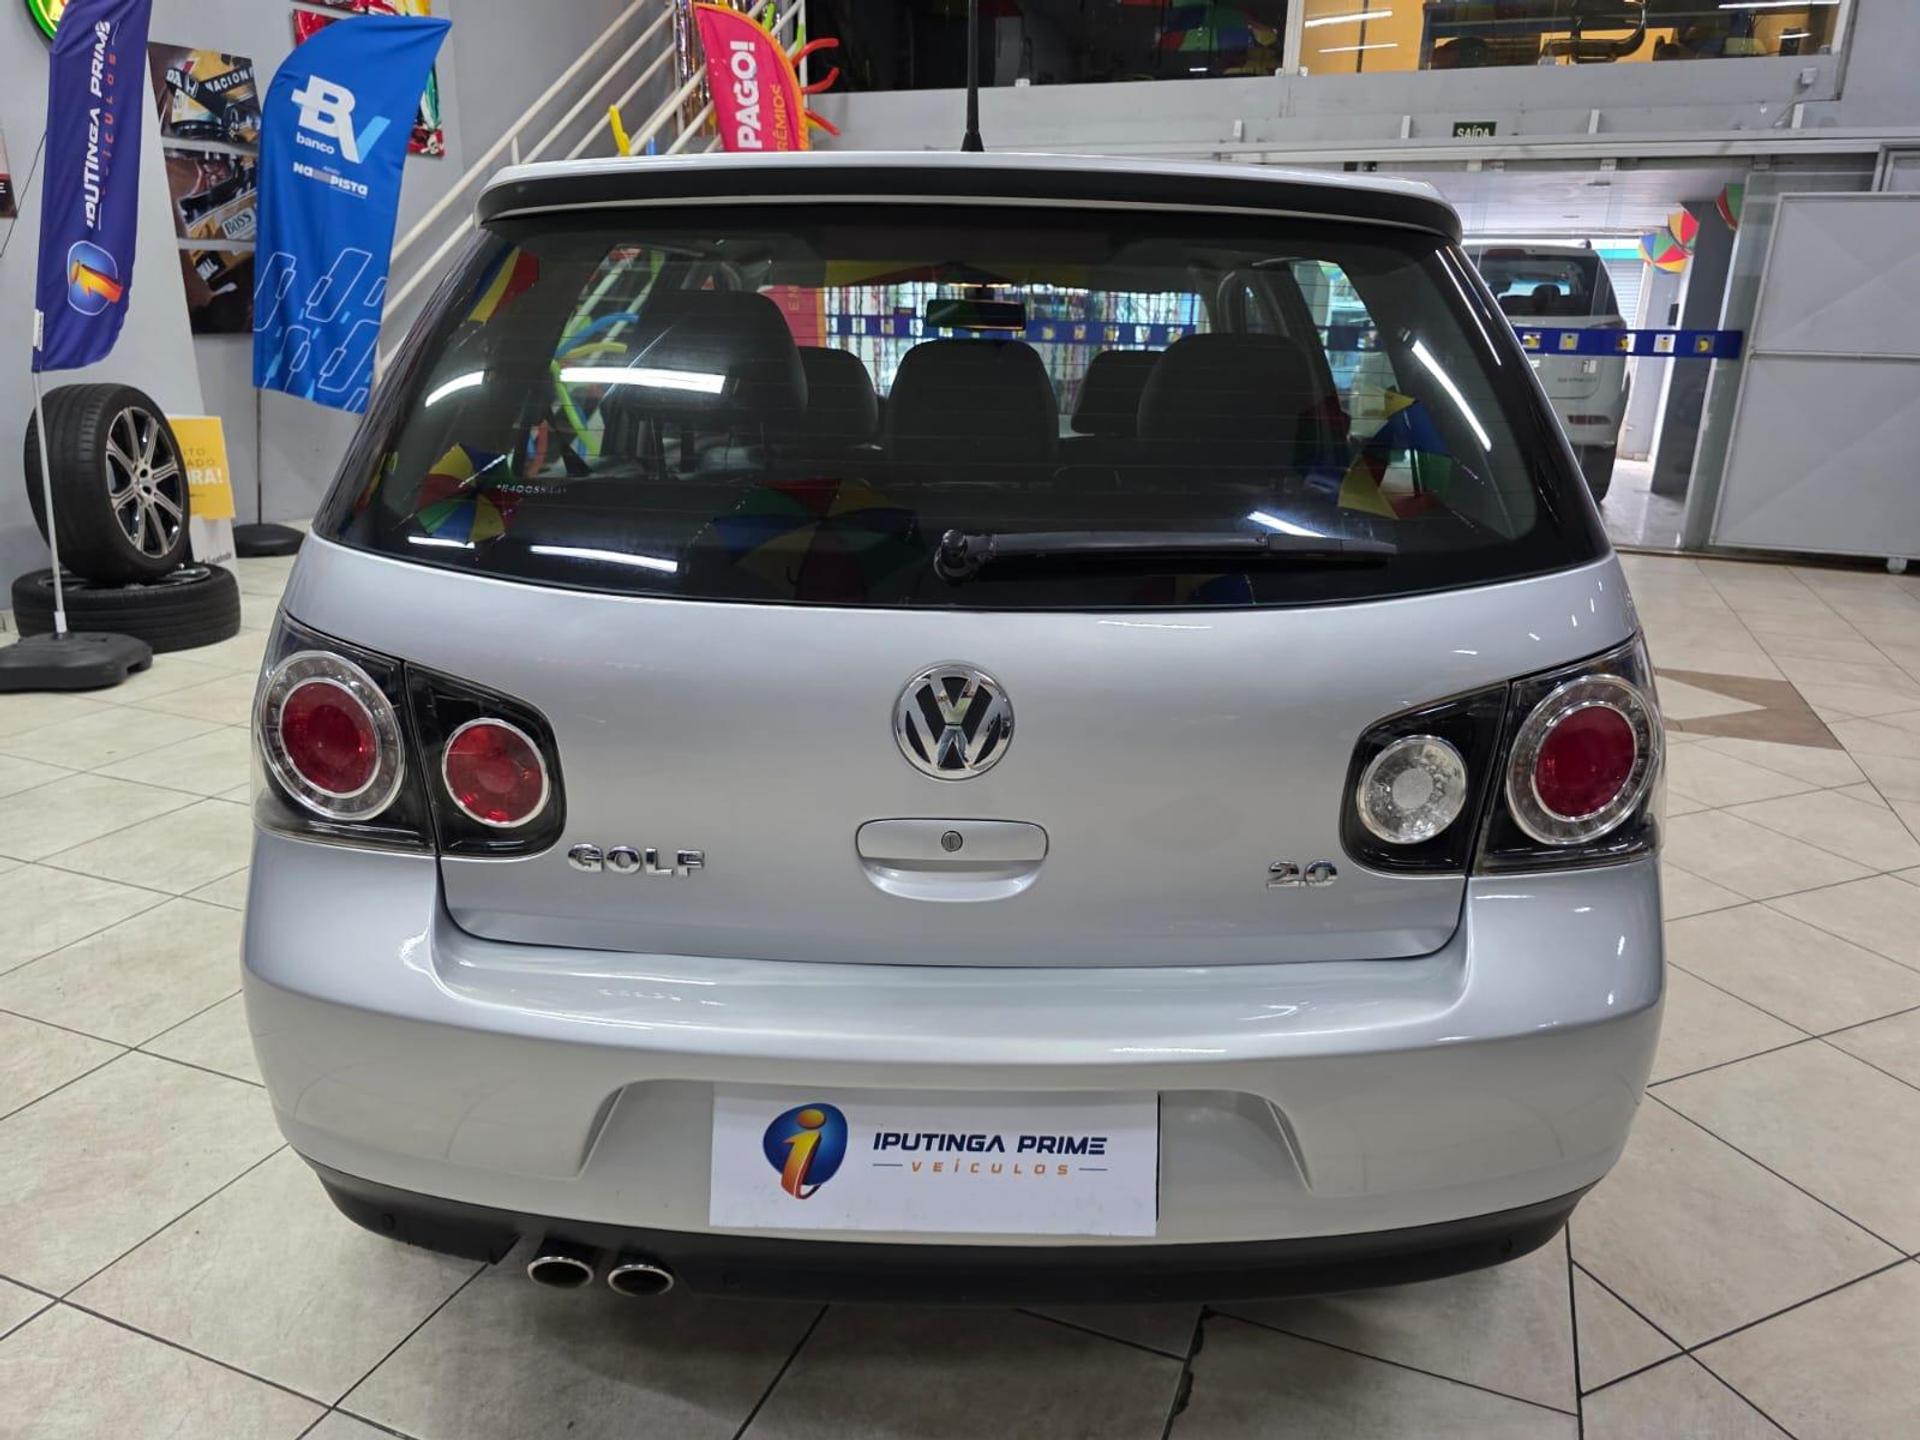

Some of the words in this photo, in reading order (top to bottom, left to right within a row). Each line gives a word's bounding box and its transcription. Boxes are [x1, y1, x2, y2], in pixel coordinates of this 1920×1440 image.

[204, 66, 256, 94] NACION
[730, 40, 763, 149] PAGO!
[770, 83, 789, 152] RÊMIOS
[296, 131, 335, 155] banco
[83, 107, 101, 229] IPUTINGA
[567, 843, 705, 877] GOLF
[1266, 860, 1338, 888] 2.0
[872, 1132, 1006, 1154] IPUTINGA
[1016, 1135, 1109, 1156] PRIME
[911, 1158, 1069, 1177] VEÍCULOS
